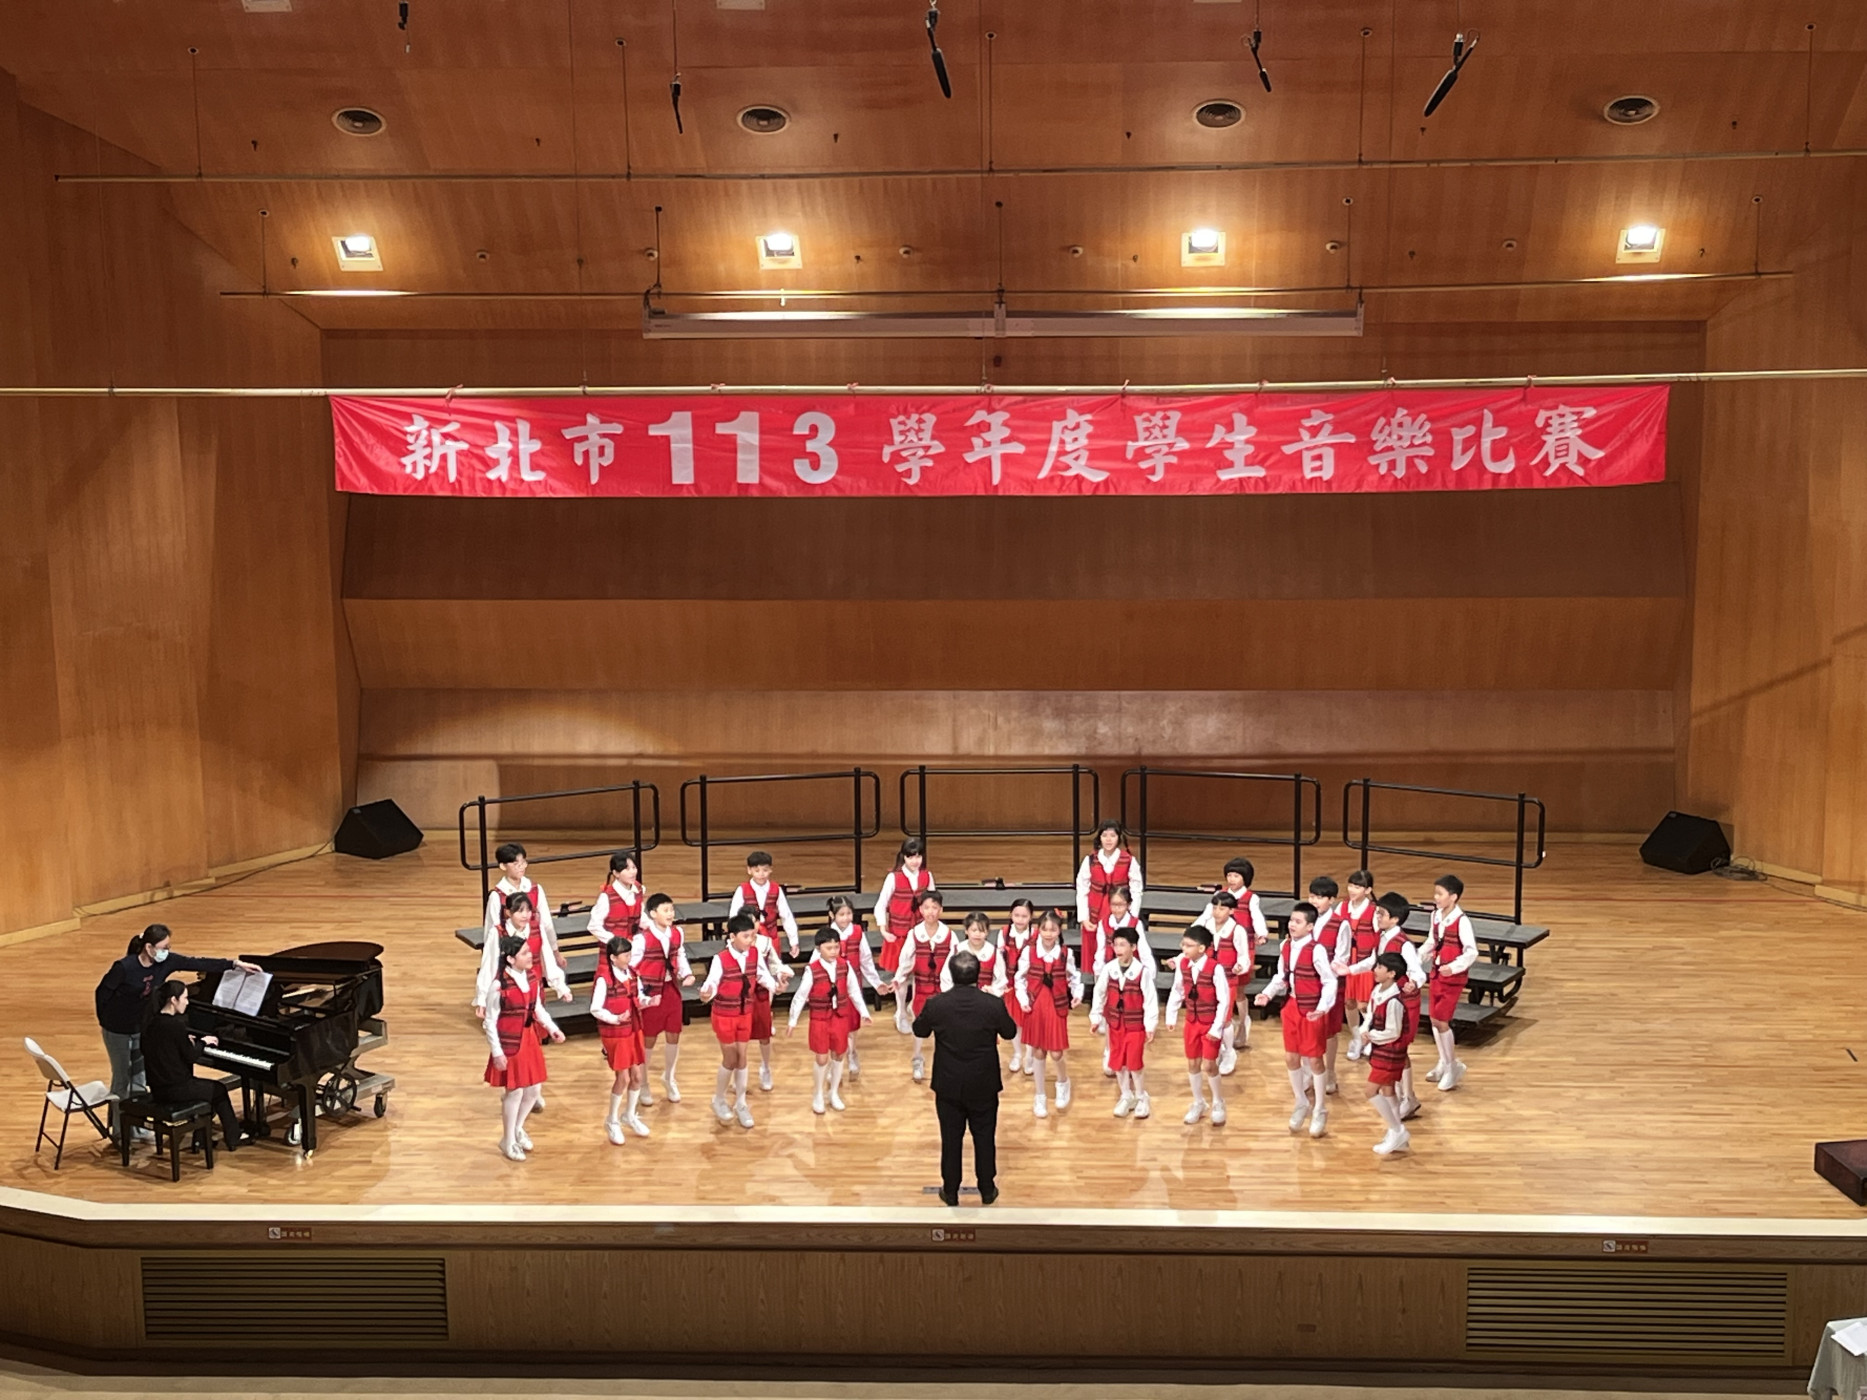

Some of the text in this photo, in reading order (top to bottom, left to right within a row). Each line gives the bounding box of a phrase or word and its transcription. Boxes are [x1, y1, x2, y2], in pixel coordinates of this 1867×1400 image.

[400, 406, 1606, 486] 新北市113學年度學生音樂比賽
